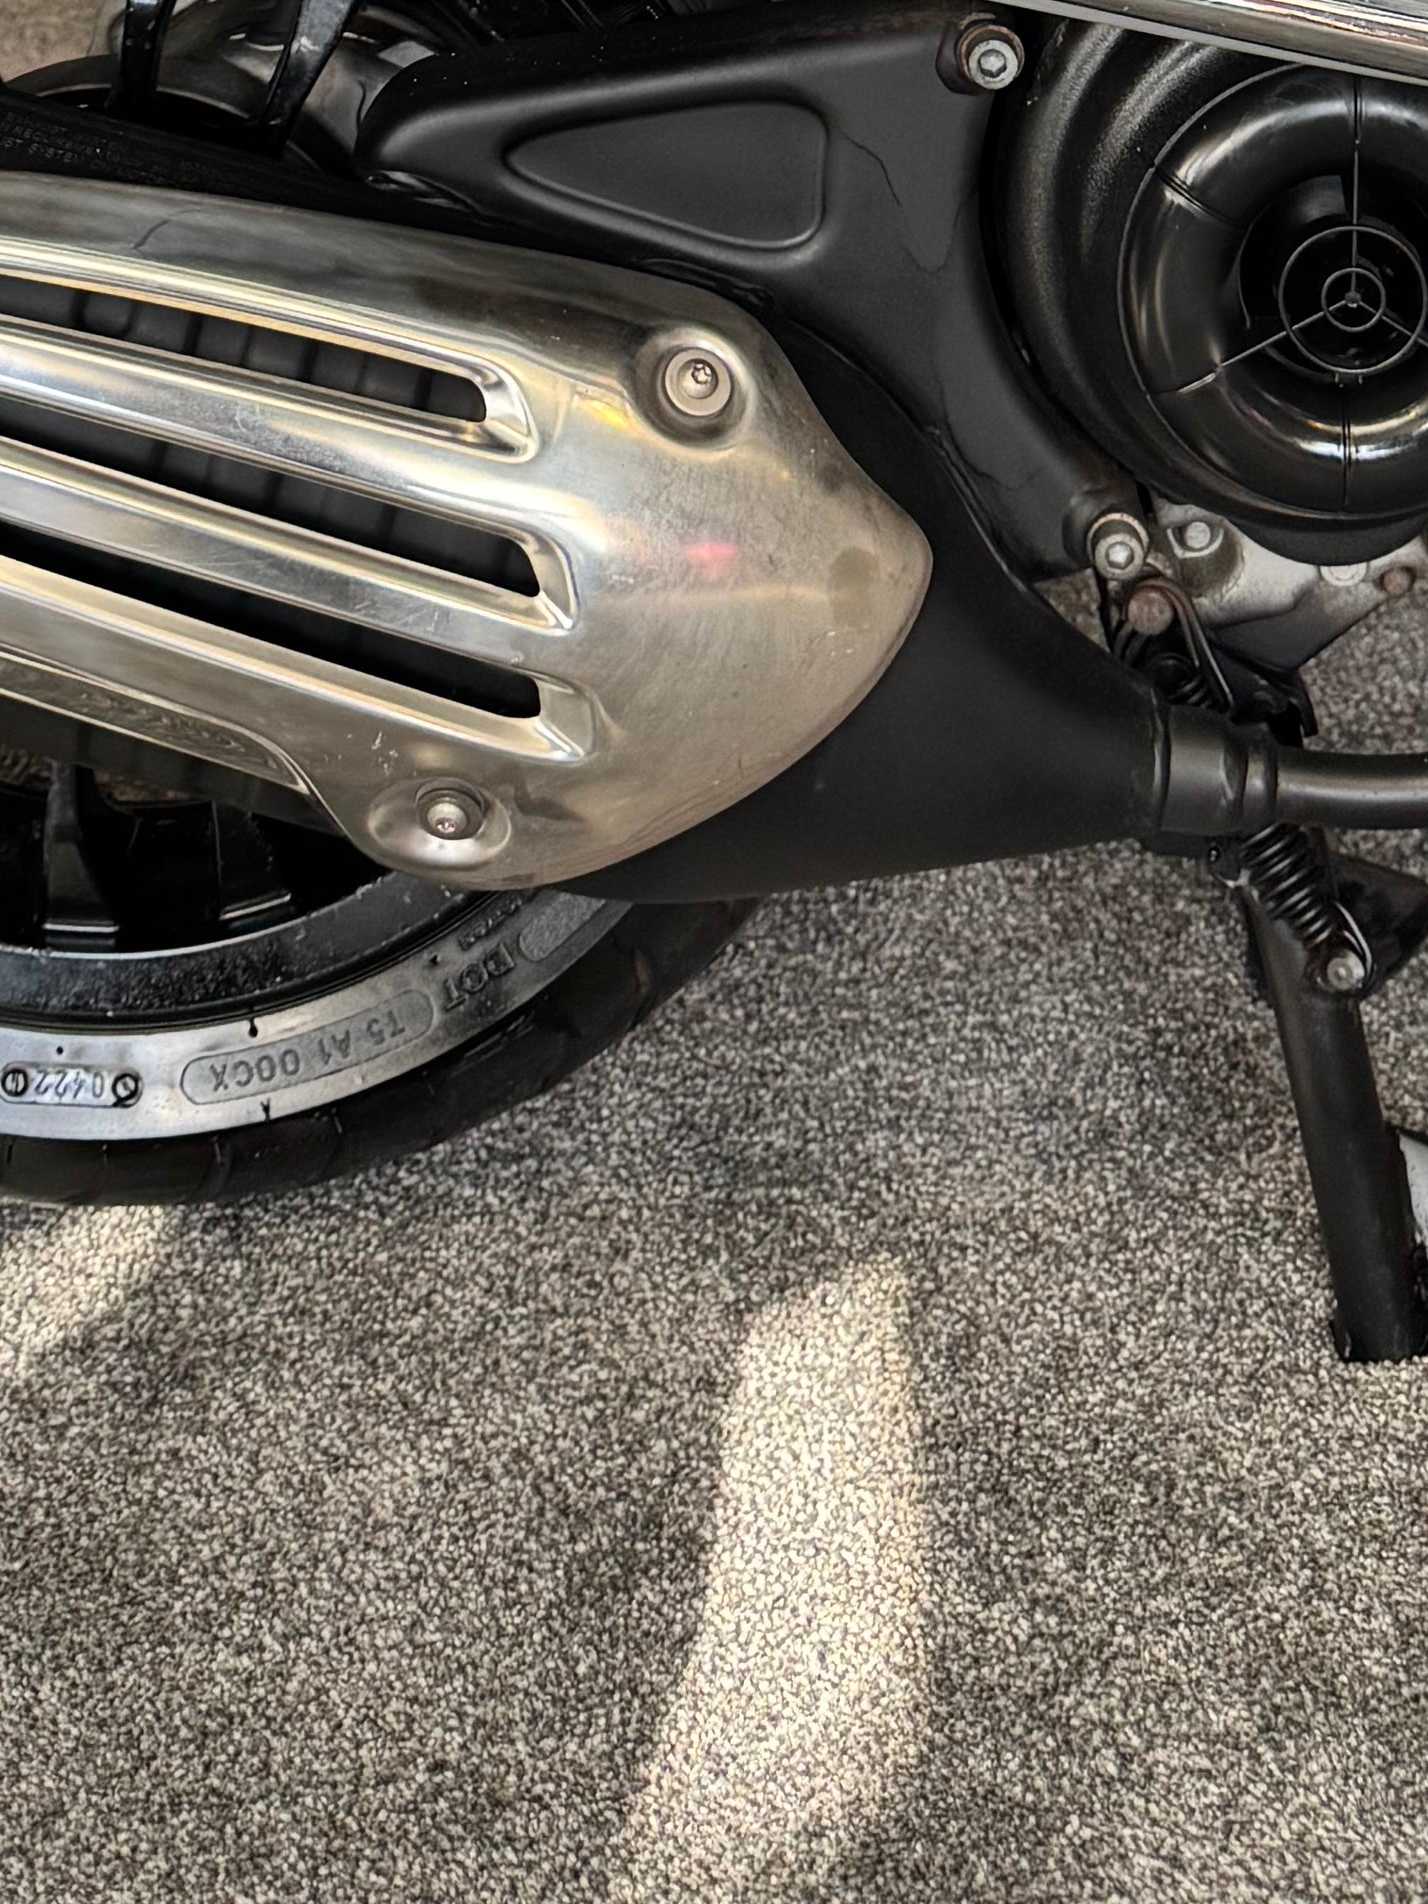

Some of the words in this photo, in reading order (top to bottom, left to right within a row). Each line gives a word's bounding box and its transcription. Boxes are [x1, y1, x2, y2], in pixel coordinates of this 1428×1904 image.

[439, 942, 515, 1013] DOT
[364, 1009, 406, 1046] T5
[315, 1029, 354, 1065] A1
[35, 1069, 105, 1100] 0422
